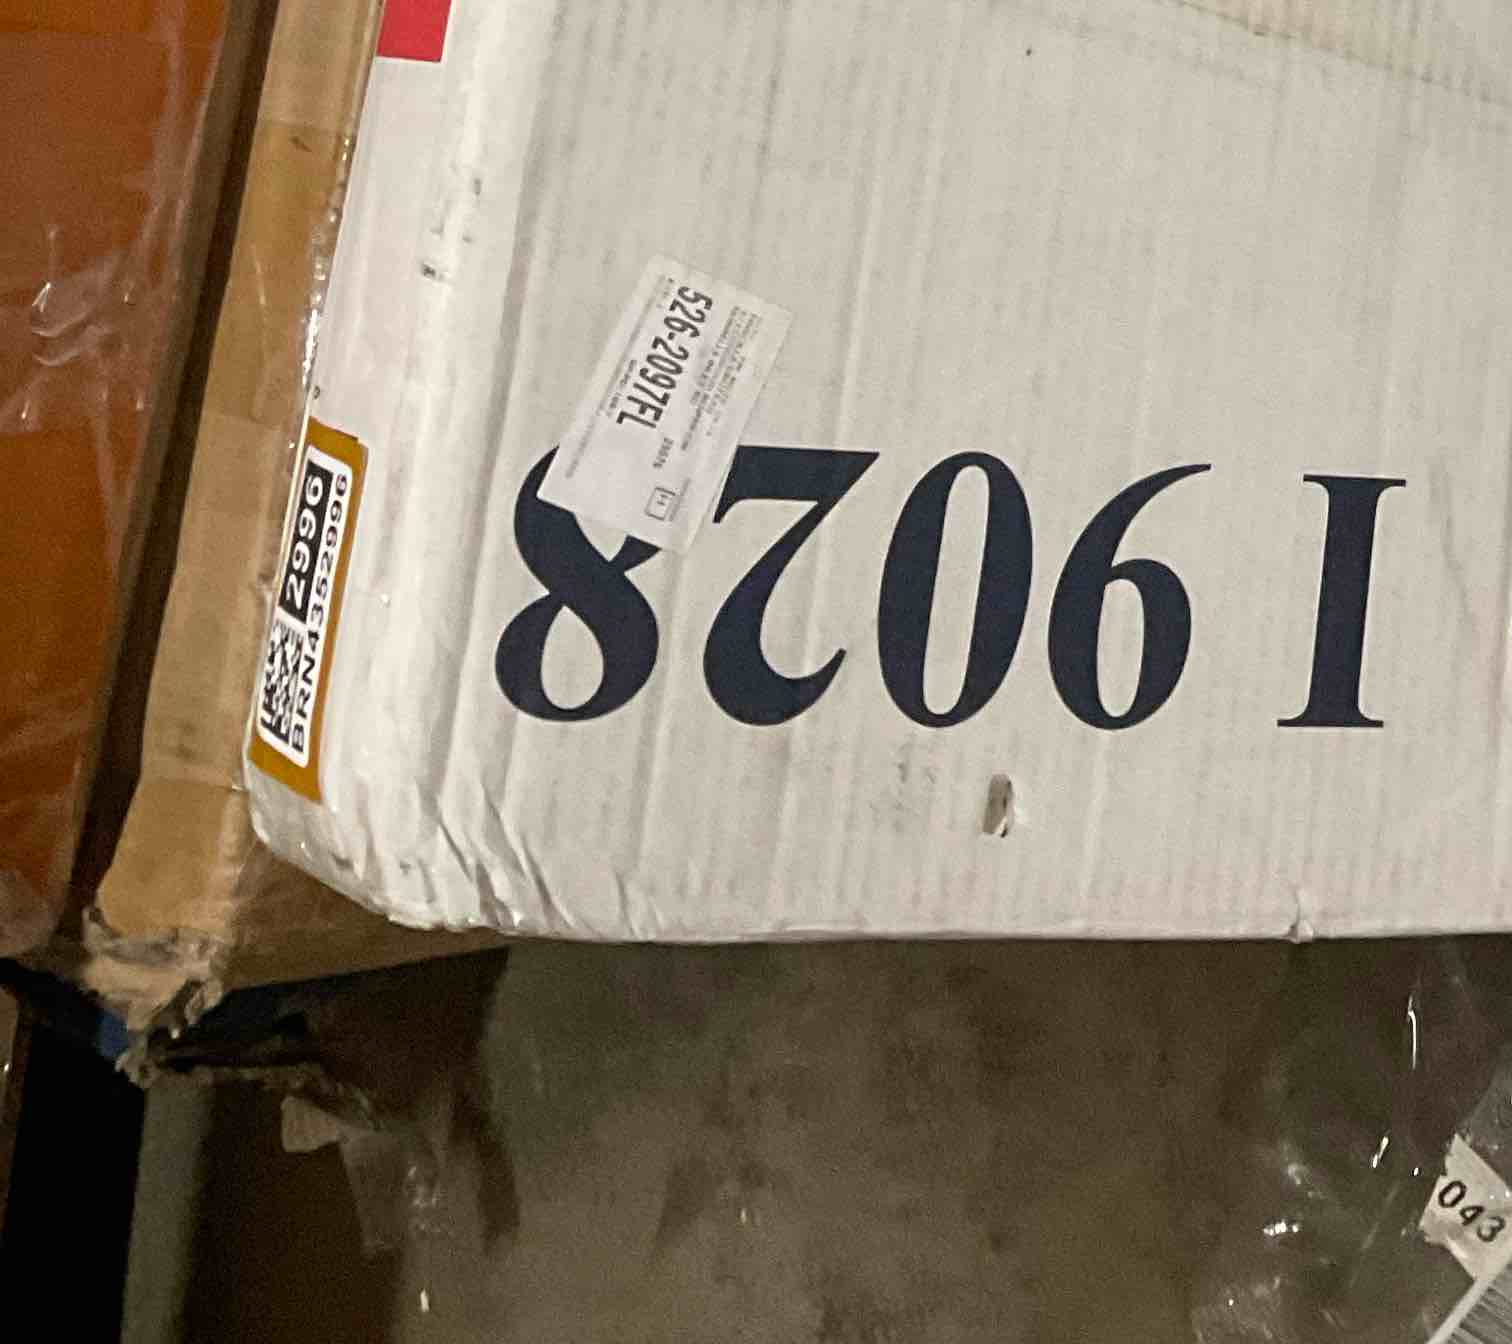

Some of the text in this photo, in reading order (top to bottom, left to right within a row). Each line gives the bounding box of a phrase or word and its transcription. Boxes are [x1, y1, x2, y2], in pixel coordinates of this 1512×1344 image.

[615, 284, 714, 431] 526-2097FL
[282, 473, 326, 603] 2996
[495, 443, 1407, 731] I 9028
